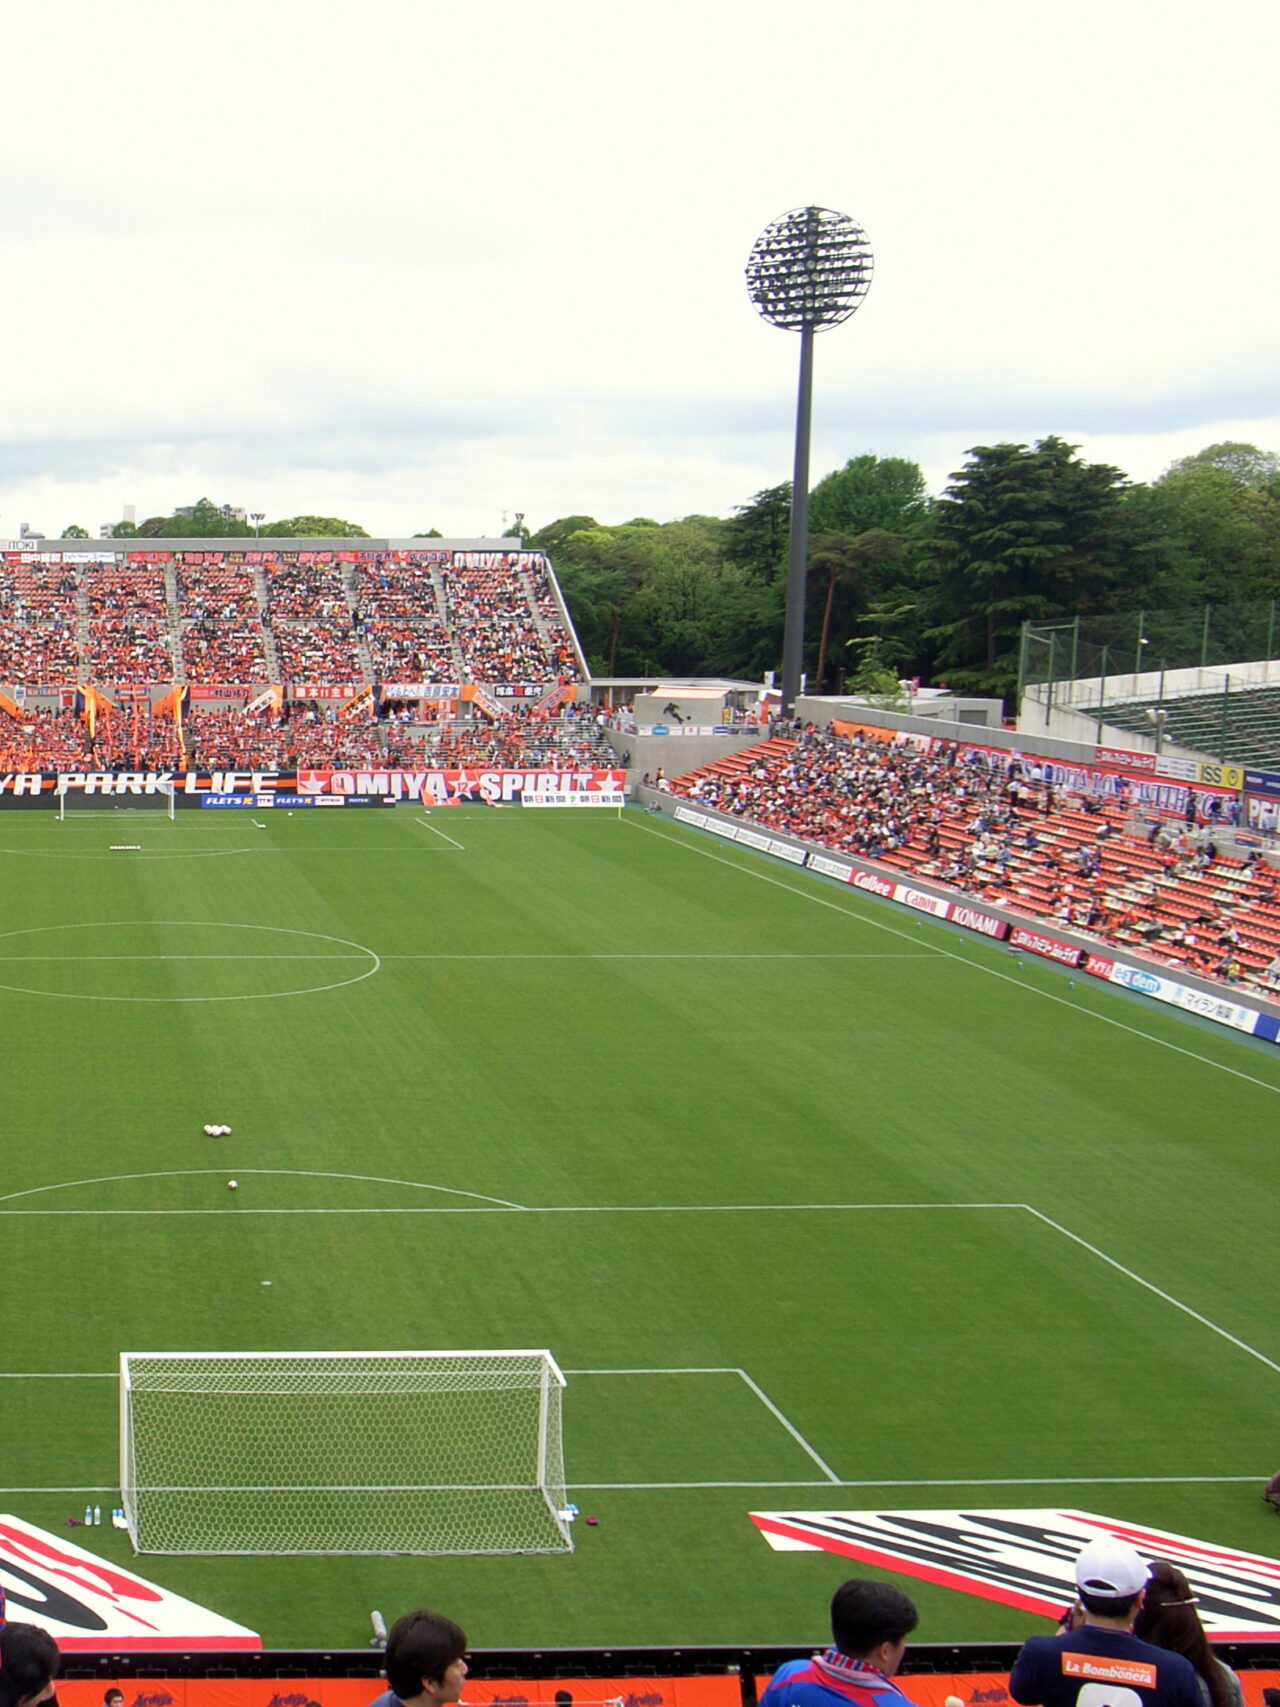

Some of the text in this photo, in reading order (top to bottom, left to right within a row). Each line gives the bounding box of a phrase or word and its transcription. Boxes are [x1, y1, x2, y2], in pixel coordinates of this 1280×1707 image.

[55, 773, 175, 795] PARK
[184, 772, 280, 795] LIFE
[331, 772, 595, 801] OMIYA 12 SPIRIT
[1201, 765, 1222, 784] ISS
[854, 872, 891, 896] Calbee
[904, 890, 938, 912] Canon
[951, 905, 1000, 937] KONAMI
[1065, 1660, 1080, 1673] La
[1082, 1662, 1153, 1685] Bombonera
